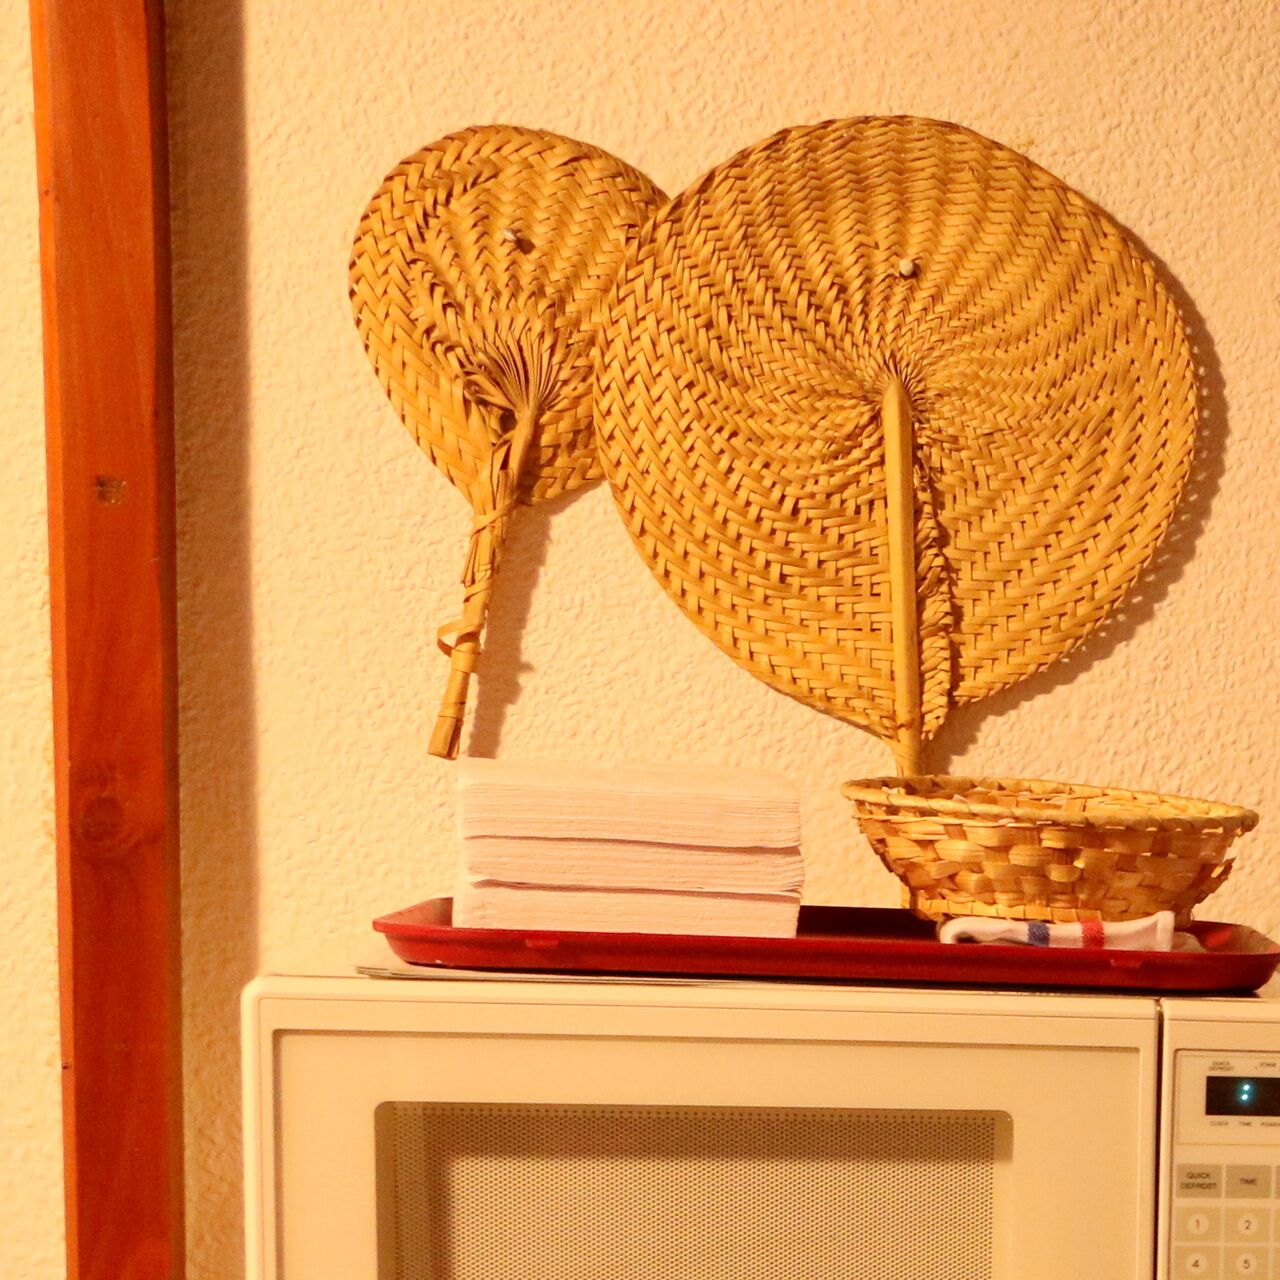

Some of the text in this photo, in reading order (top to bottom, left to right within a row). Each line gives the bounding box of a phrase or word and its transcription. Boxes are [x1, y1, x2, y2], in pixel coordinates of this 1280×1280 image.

[1180, 1182, 1216, 1190] DEFROST
[1239, 1178, 1256, 1186] TIME
[1244, 1219, 1252, 1230] 2
[1192, 1259, 1200, 1268] 4
[1243, 1259, 1250, 1269] 5
